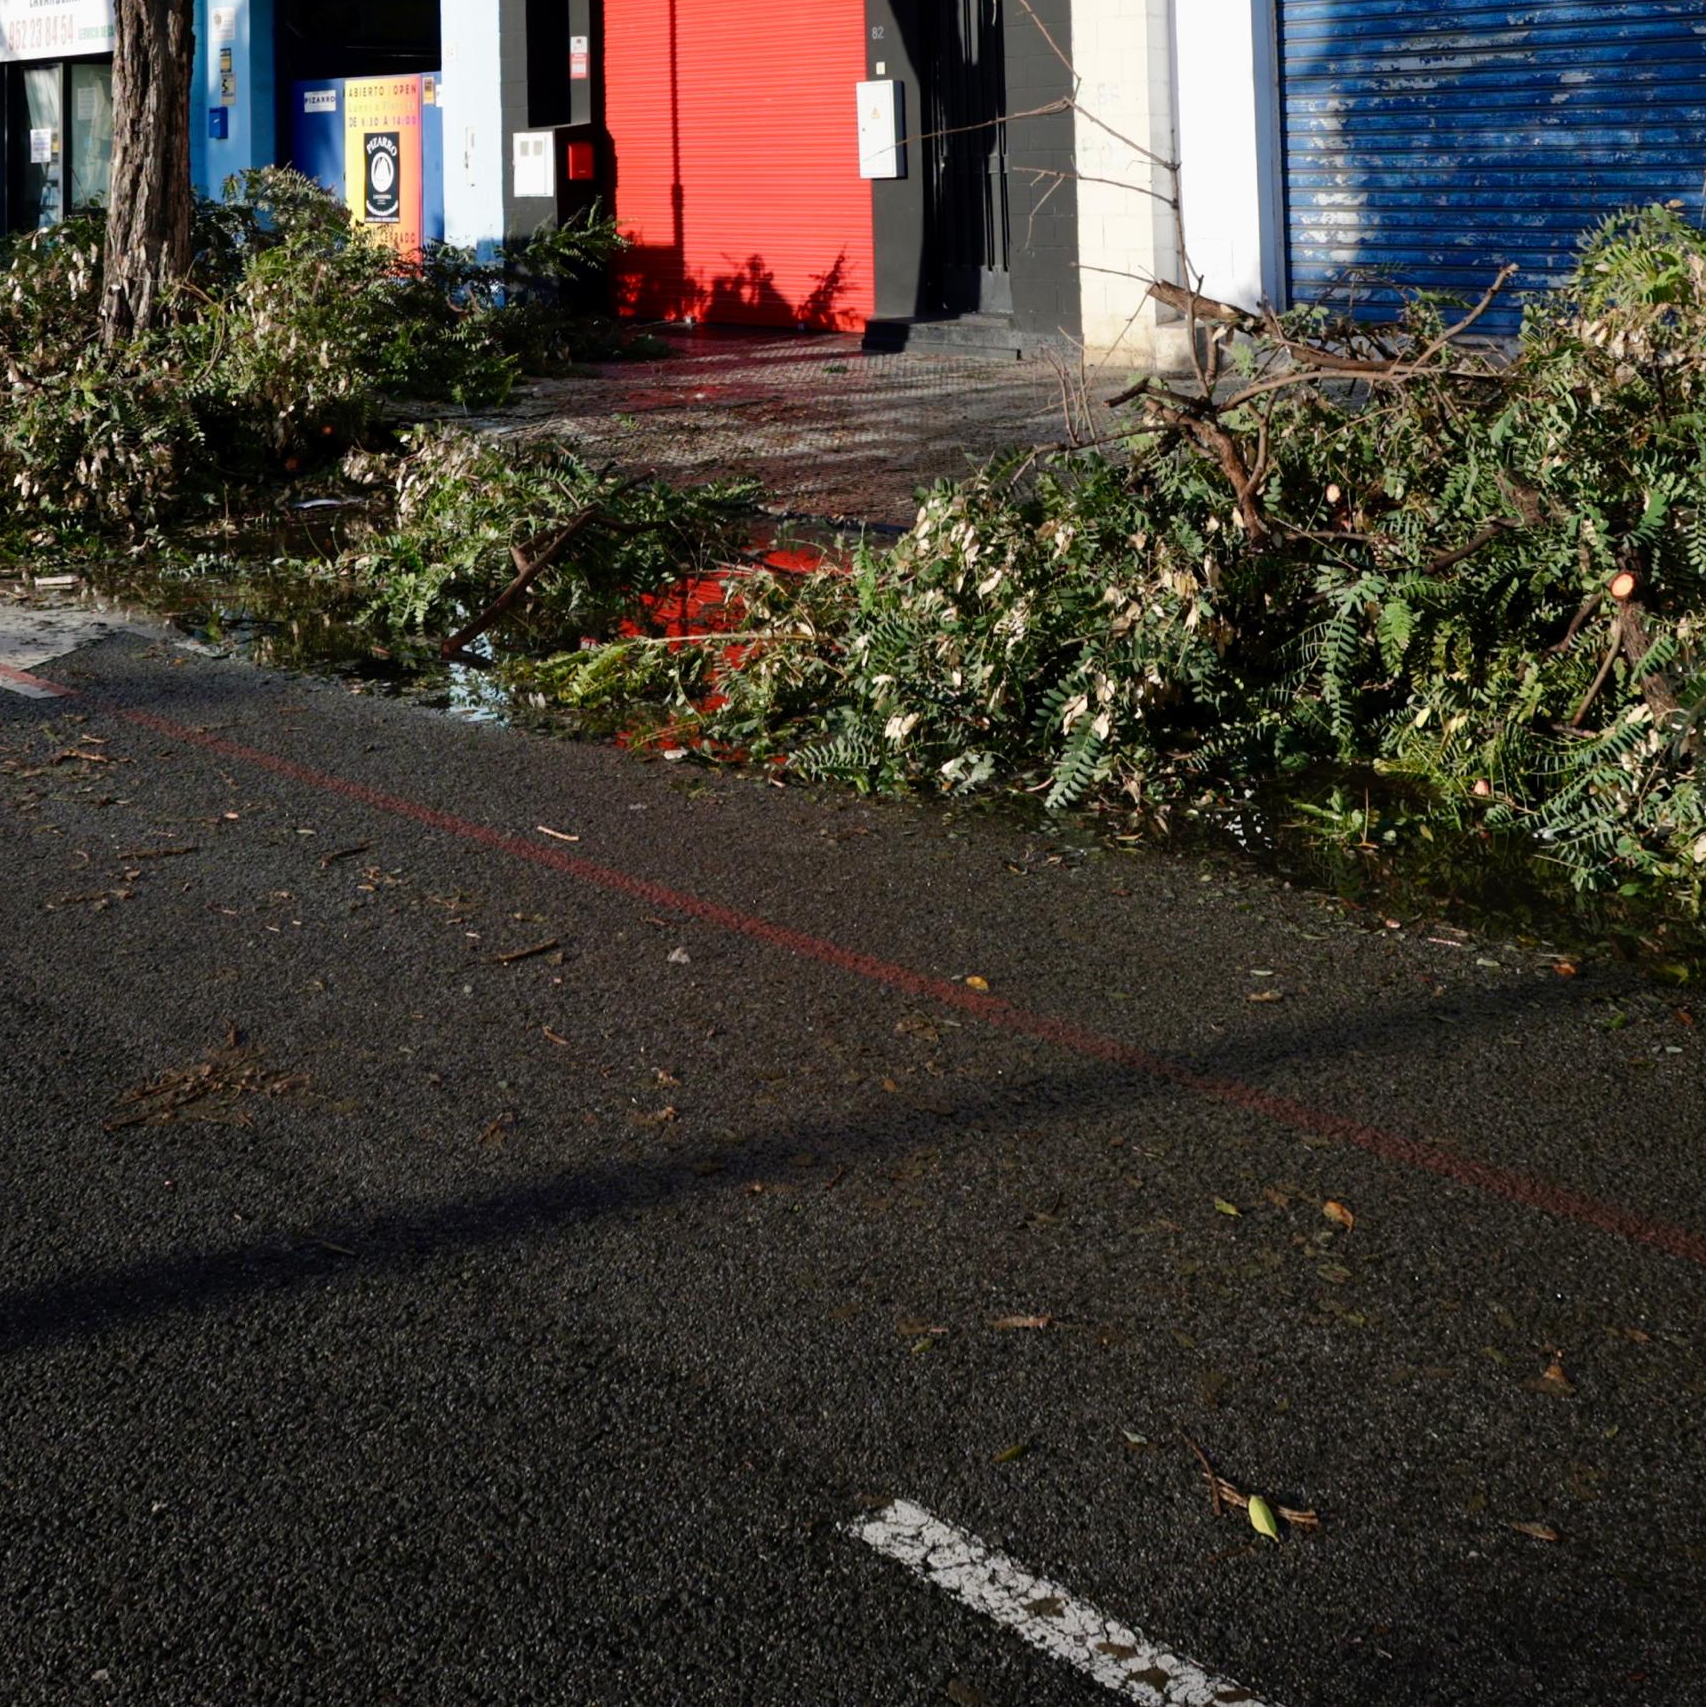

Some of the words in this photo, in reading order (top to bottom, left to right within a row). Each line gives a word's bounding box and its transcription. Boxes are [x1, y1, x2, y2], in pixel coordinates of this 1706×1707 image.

[871, 26, 885, 39] 82
[349, 86, 384, 97] ABIERTO
[393, 83, 417, 96] OPEN
[304, 95, 336, 105] PIZARRO
[366, 136, 398, 157] PIZARRO
